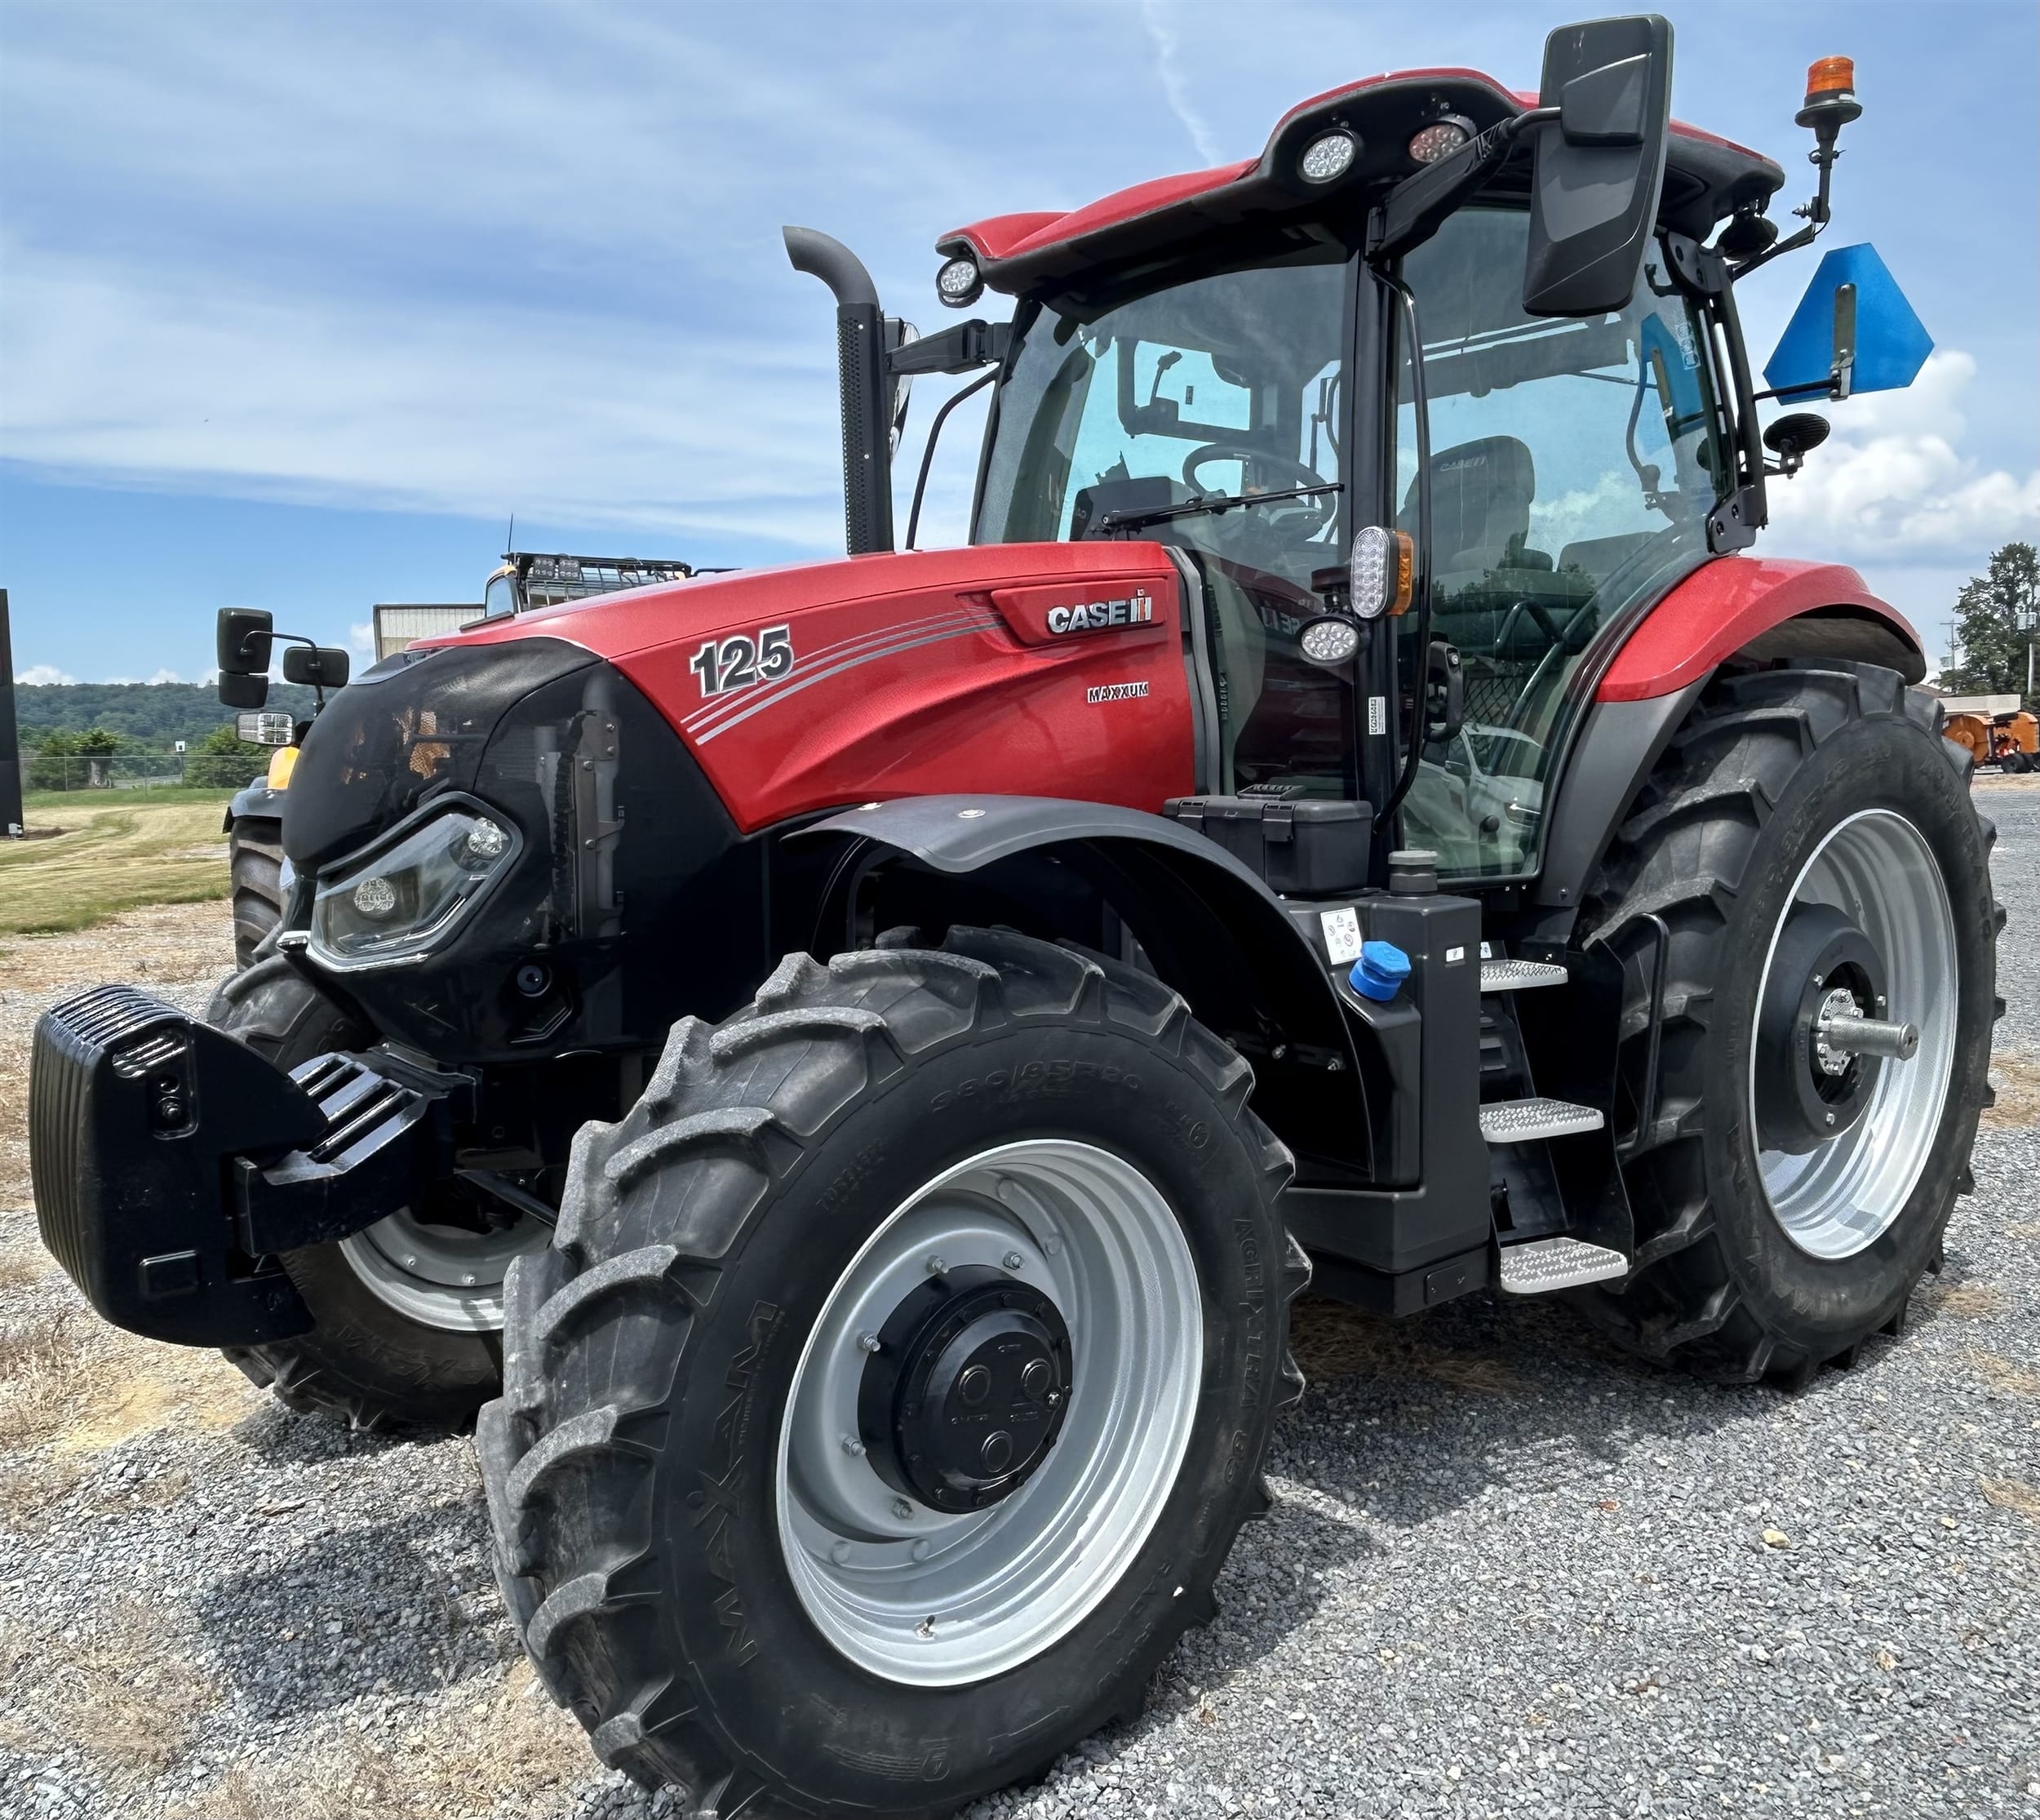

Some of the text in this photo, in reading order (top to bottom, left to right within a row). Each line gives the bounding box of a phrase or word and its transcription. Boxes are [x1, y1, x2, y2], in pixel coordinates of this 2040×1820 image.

[1046, 600, 1126, 633] CASE
[690, 623, 794, 698] 125
[1086, 681, 1149, 704] MAXXUM
